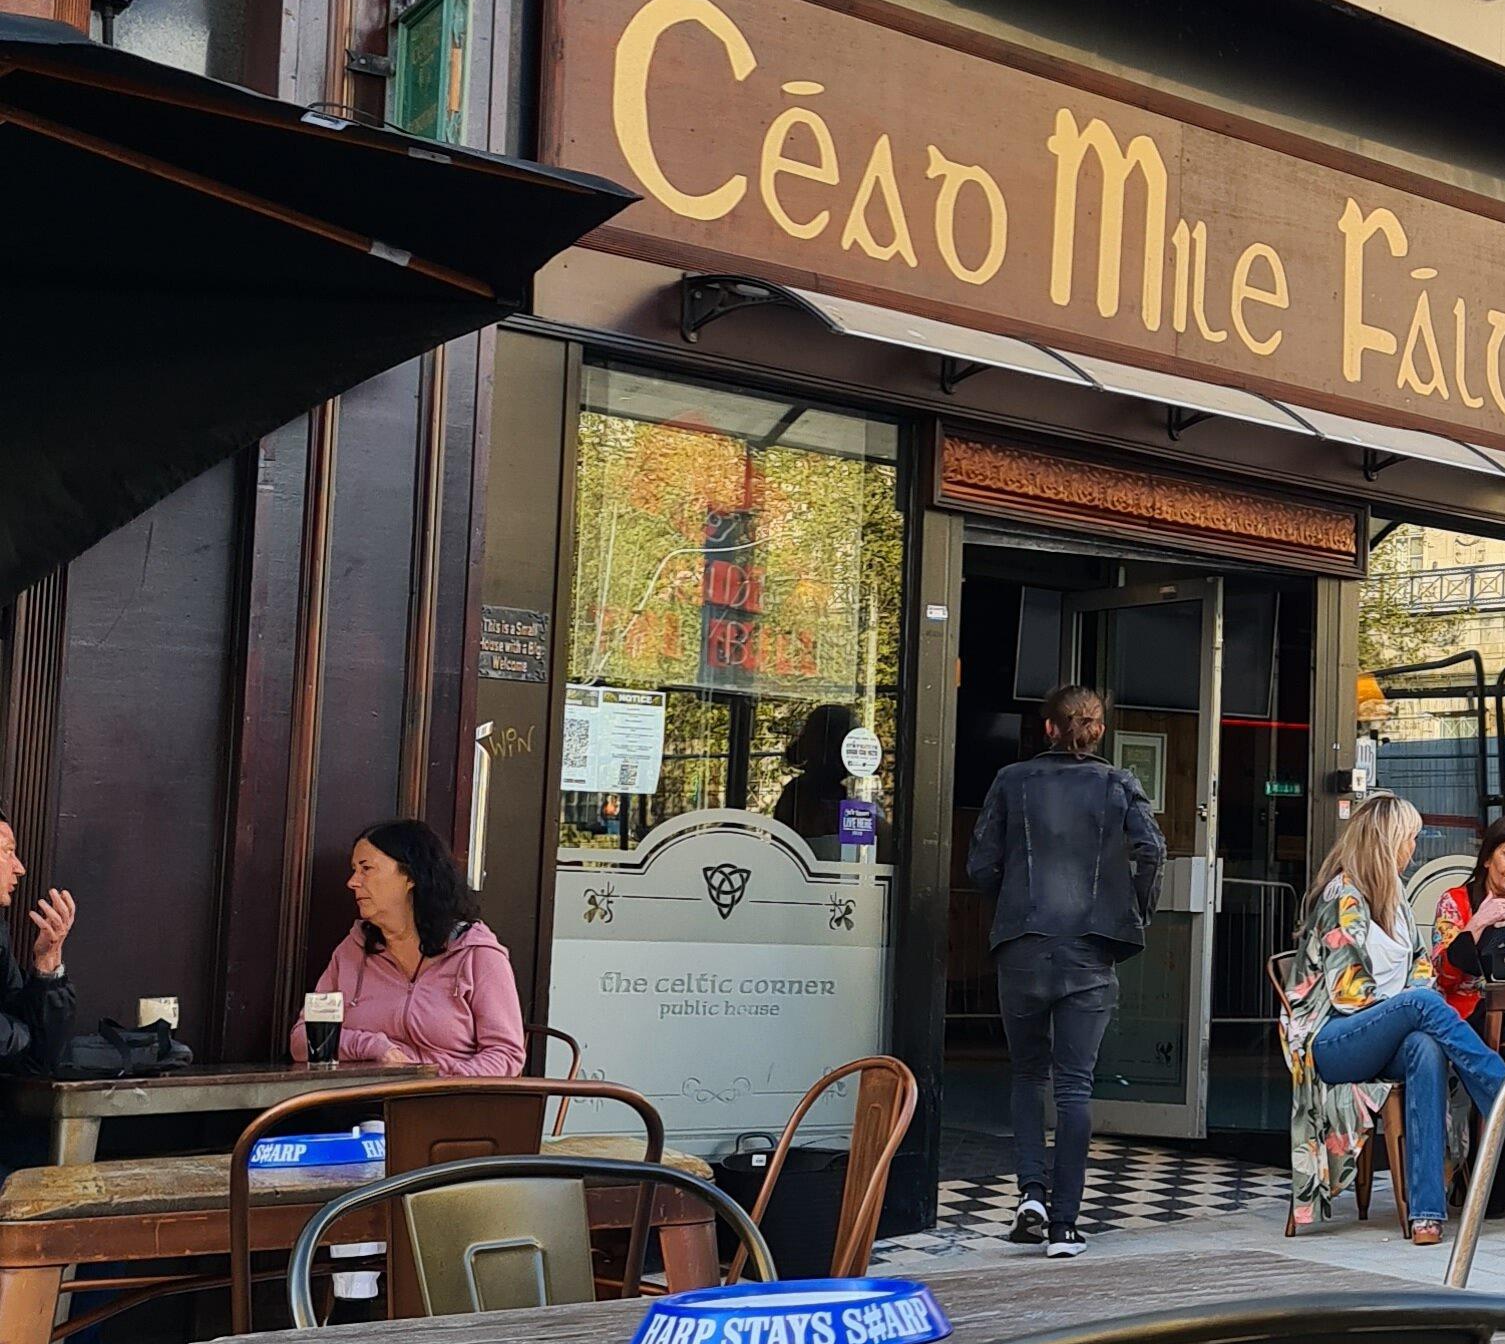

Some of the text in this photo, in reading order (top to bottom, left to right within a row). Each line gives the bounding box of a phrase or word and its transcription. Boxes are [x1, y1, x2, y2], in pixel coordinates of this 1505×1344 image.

[492, 655, 528, 672] Welcome
[618, 694, 653, 704] NOTICE
[600, 970, 648, 993] the
[654, 973, 733, 995] celtic
[659, 999, 781, 1019] public house
